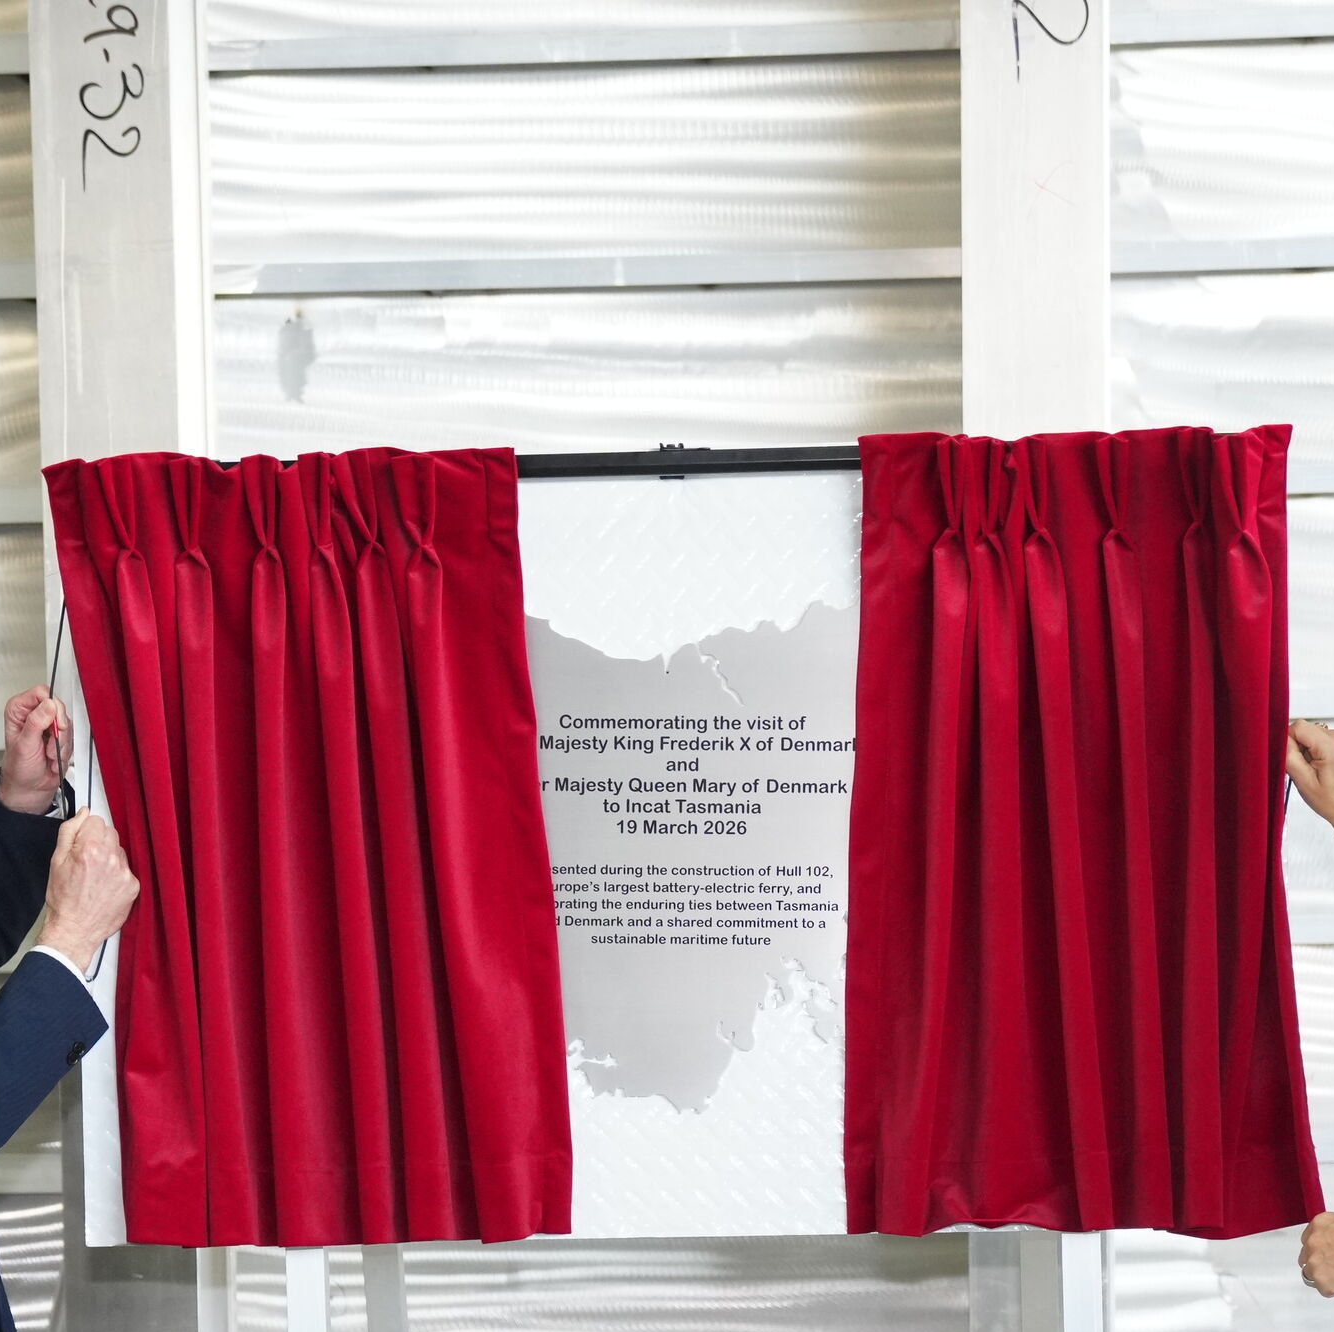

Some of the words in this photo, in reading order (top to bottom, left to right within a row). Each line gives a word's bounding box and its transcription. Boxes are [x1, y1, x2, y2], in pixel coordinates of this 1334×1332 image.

[78, 0, 144, 192] 9-32
[559, 713, 708, 734] Commemorating
[712, 715, 742, 731] the
[746, 715, 784, 731] visit
[788, 715, 807, 731] of
[539, 734, 609, 754] Majesty
[613, 735, 654, 755] King
[659, 735, 735, 751] Frederik
[739, 736, 751, 752] X
[755, 736, 774, 752] of
[665, 757, 699, 772] and
[554, 776, 624, 796] Majesty
[628, 777, 687, 794] Queen
[692, 778, 737, 797] Mary
[741, 778, 760, 794] of
[766, 778, 848, 794] Denmark
[602, 798, 621, 814] to
[626, 798, 672, 814] Incat
[674, 798, 762, 815] Tasmania
[616, 819, 638, 835] 19
[643, 819, 698, 835] March
[703, 820, 747, 836] 2026
[549, 863, 597, 875] sented
[600, 864, 643, 879] during
[646, 864, 668, 876] the
[671, 865, 755, 877] construction
[758, 865, 772, 877] of
[776, 865, 802, 877] Hull
[805, 865, 833, 879] 102,
[551, 881, 601, 895] urope’s
[603, 881, 650, 896] largest
[652, 881, 755, 896] battery-electric
[758, 882, 793, 897] ferry,
[796, 883, 822, 894] and
[601, 898, 623, 910] the
[625, 898, 685, 913] enduring
[688, 899, 713, 911] ties
[715, 899, 772, 911] between
[775, 900, 839, 912] Tasmania
[564, 915, 624, 927] Denmark
[627, 916, 652, 928] and
[655, 918, 664, 928] a
[666, 916, 713, 928] shared
[716, 917, 799, 929] commitment
[801, 917, 815, 929] to
[818, 920, 826, 929] a
[590, 933, 667, 945] sustainable
[670, 934, 728, 946] maritime
[731, 934, 771, 946] future
